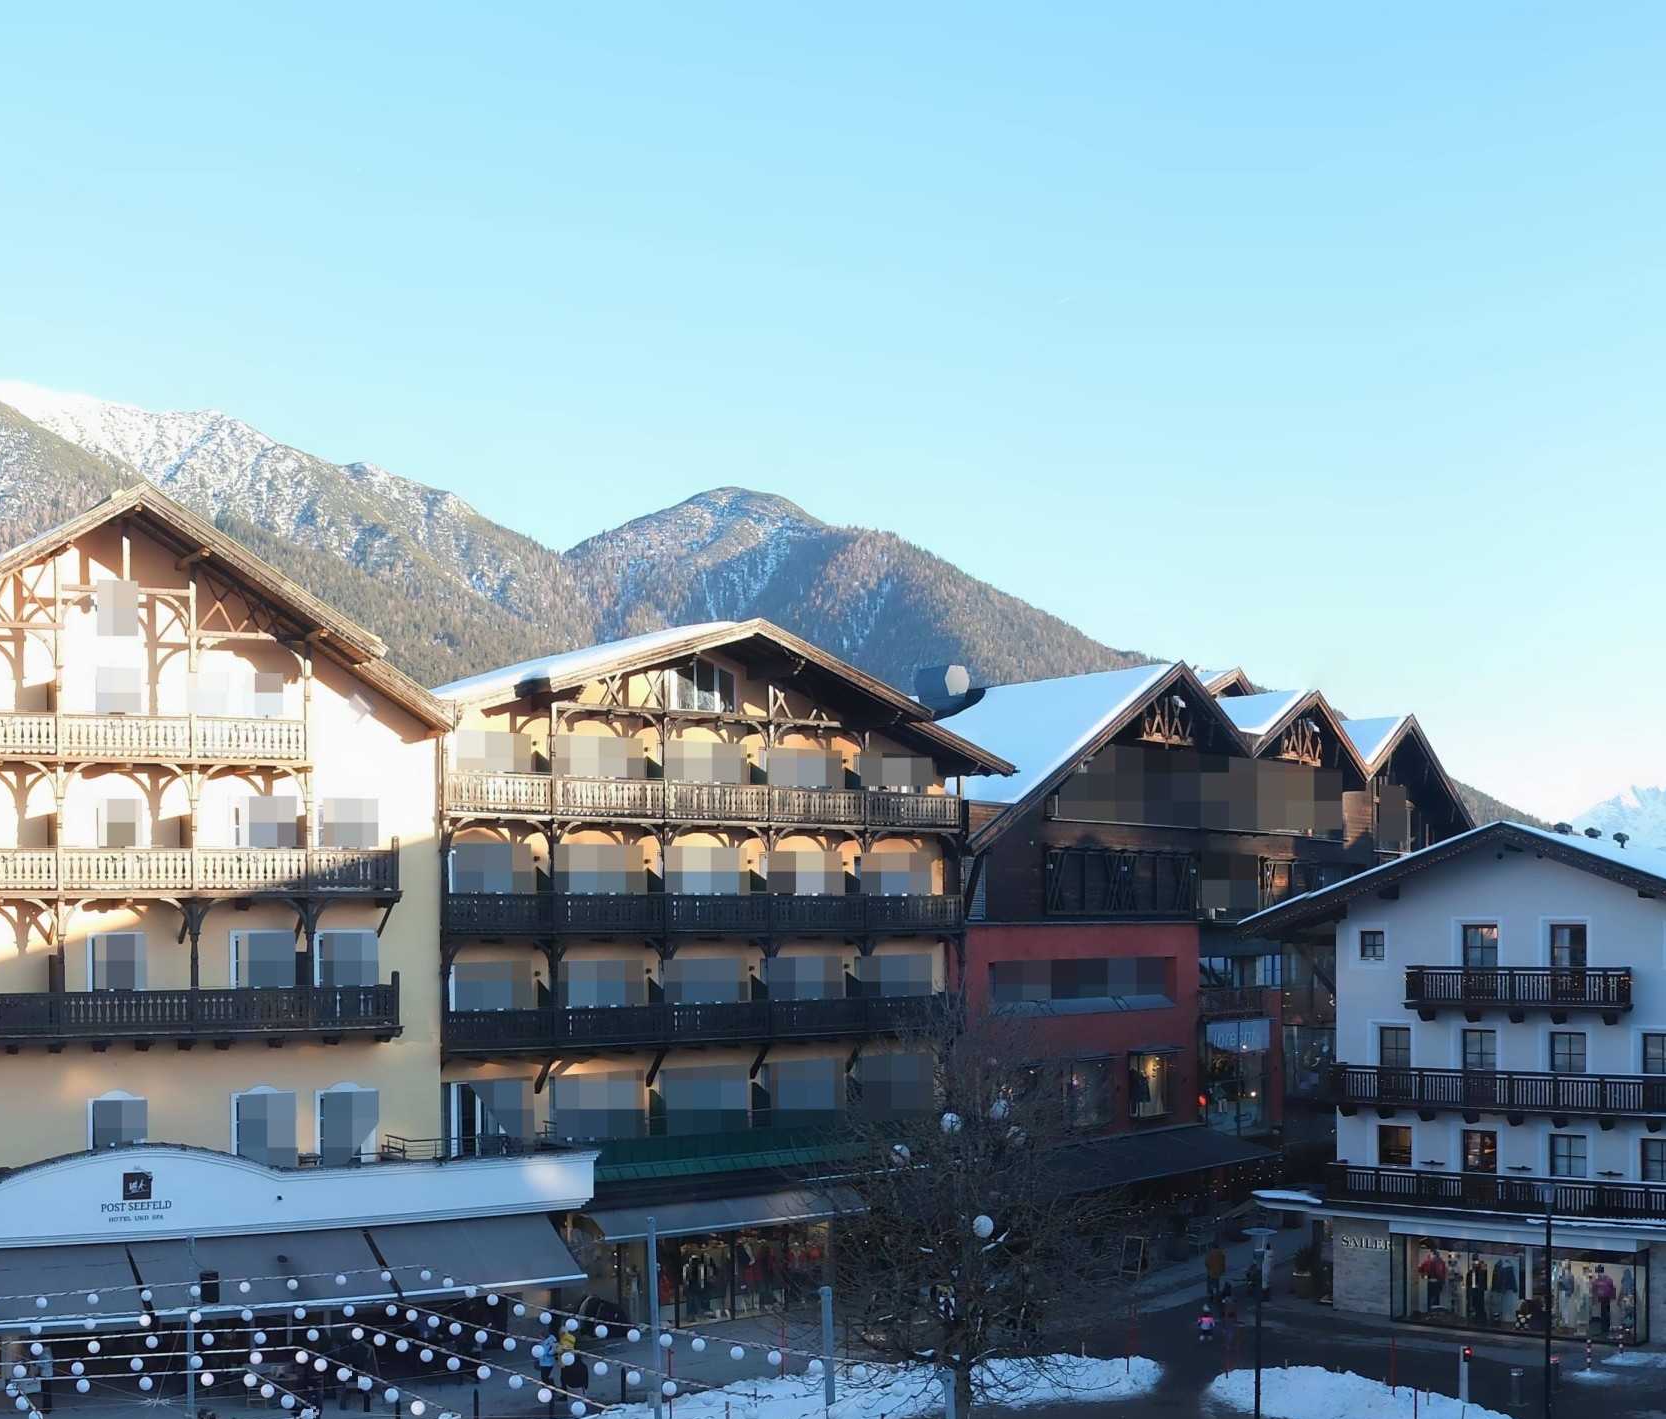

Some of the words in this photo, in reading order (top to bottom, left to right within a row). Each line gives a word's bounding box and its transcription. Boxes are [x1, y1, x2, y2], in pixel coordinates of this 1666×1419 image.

[100, 1202, 126, 1213] POST
[128, 1200, 172, 1211] SEEFELD
[108, 1215, 132, 1223] HOTEL
[151, 1213, 164, 1221] SPA
[1341, 1235, 1395, 1252] SAILER
